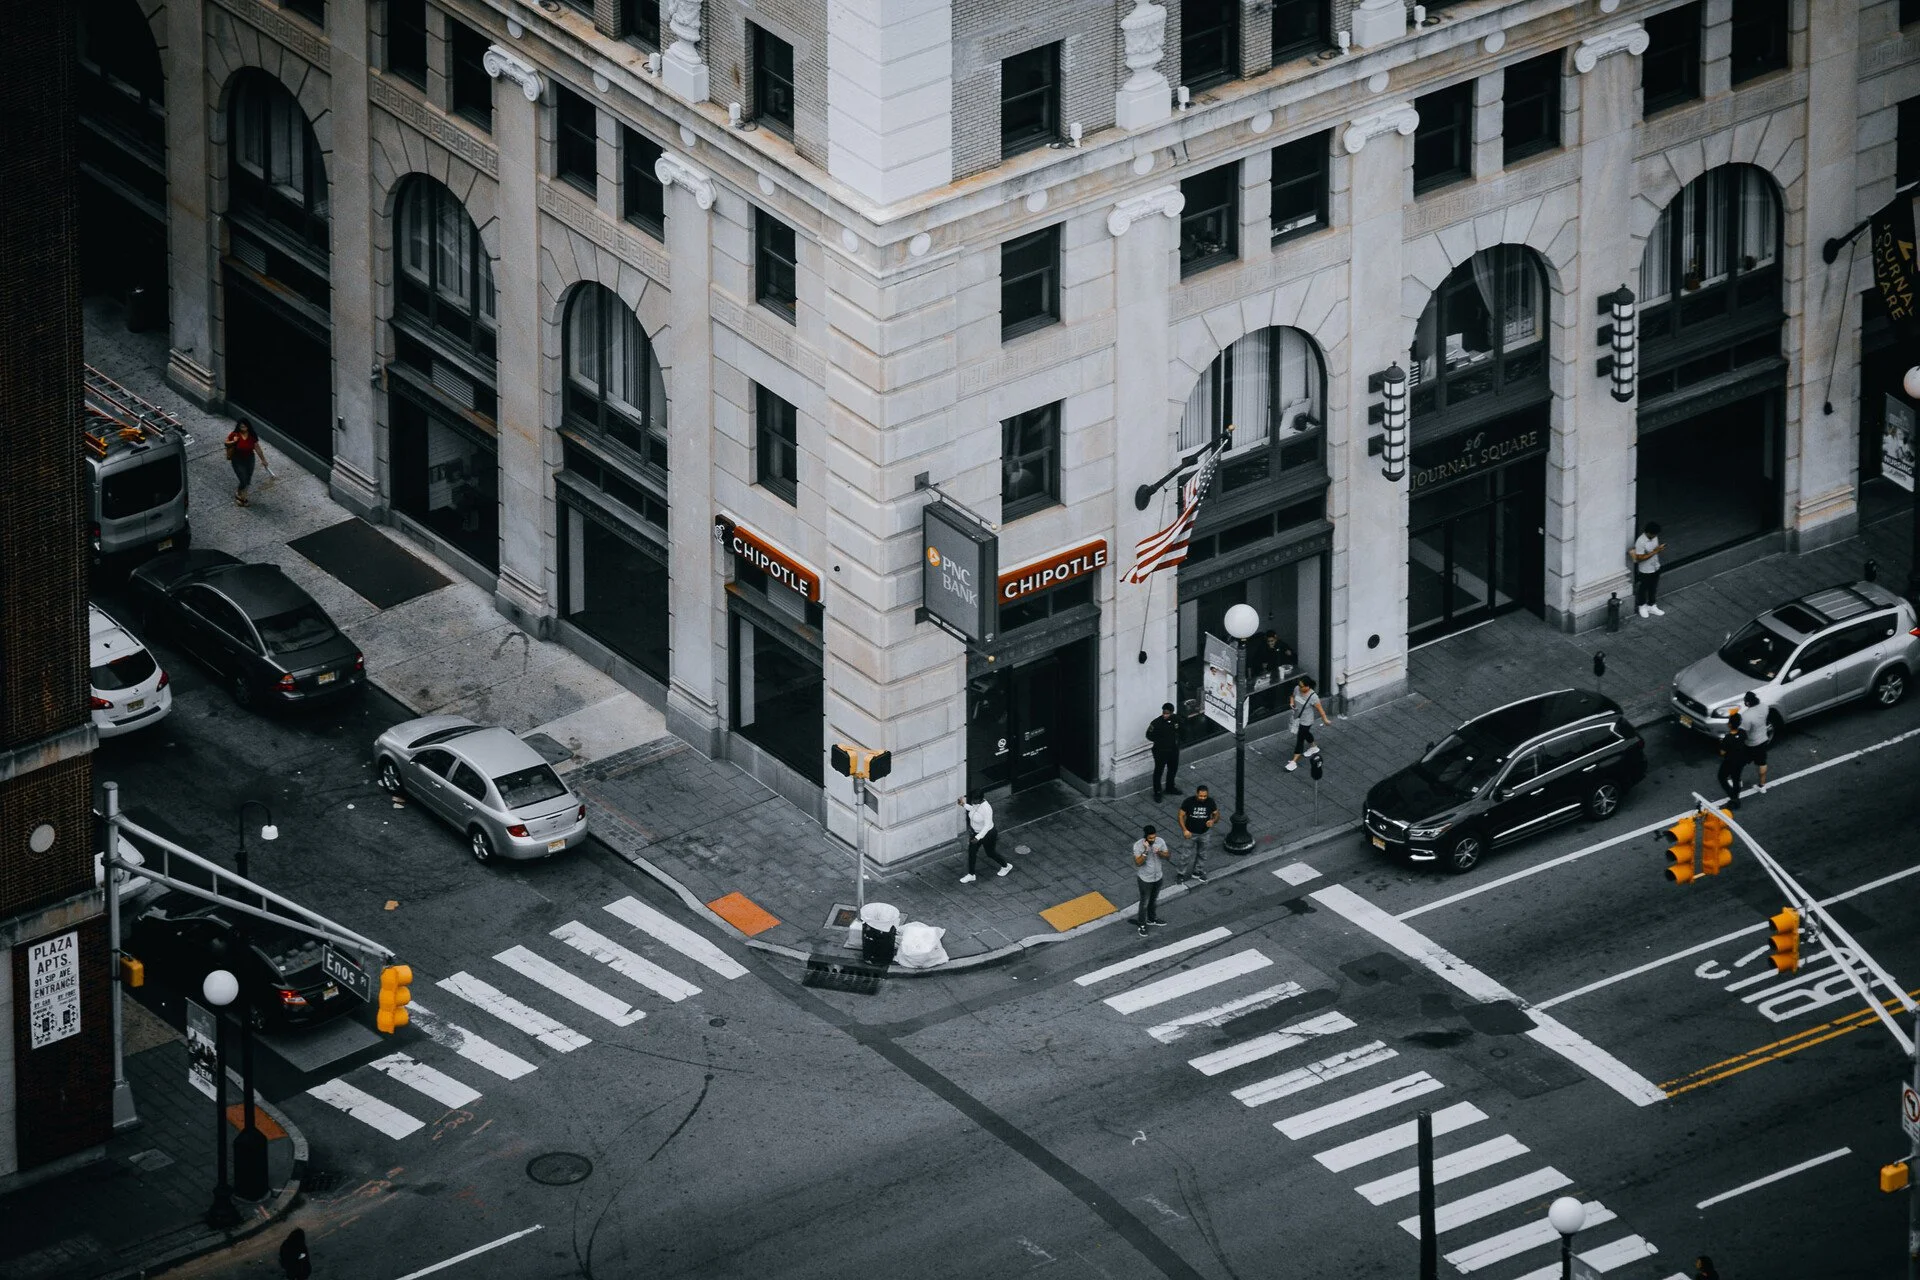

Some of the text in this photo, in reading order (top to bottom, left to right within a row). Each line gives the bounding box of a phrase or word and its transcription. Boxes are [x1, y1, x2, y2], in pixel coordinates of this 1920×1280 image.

[1410, 430, 1538, 492] JOURNAL SQUARE
[732, 537, 808, 597] CHIPOTLE
[941, 555, 971, 586] PNC
[1004, 549, 1106, 598] CHIPOTLE
[942, 573, 978, 608] BANK
[34, 936, 72, 960] PLAZA
[37, 953, 71, 975] APTS.
[34, 977, 42, 987] 91
[45, 973, 56, 984] SIP
[326, 952, 355, 985] Enos
[34, 976, 75, 999] ENTRANCE
